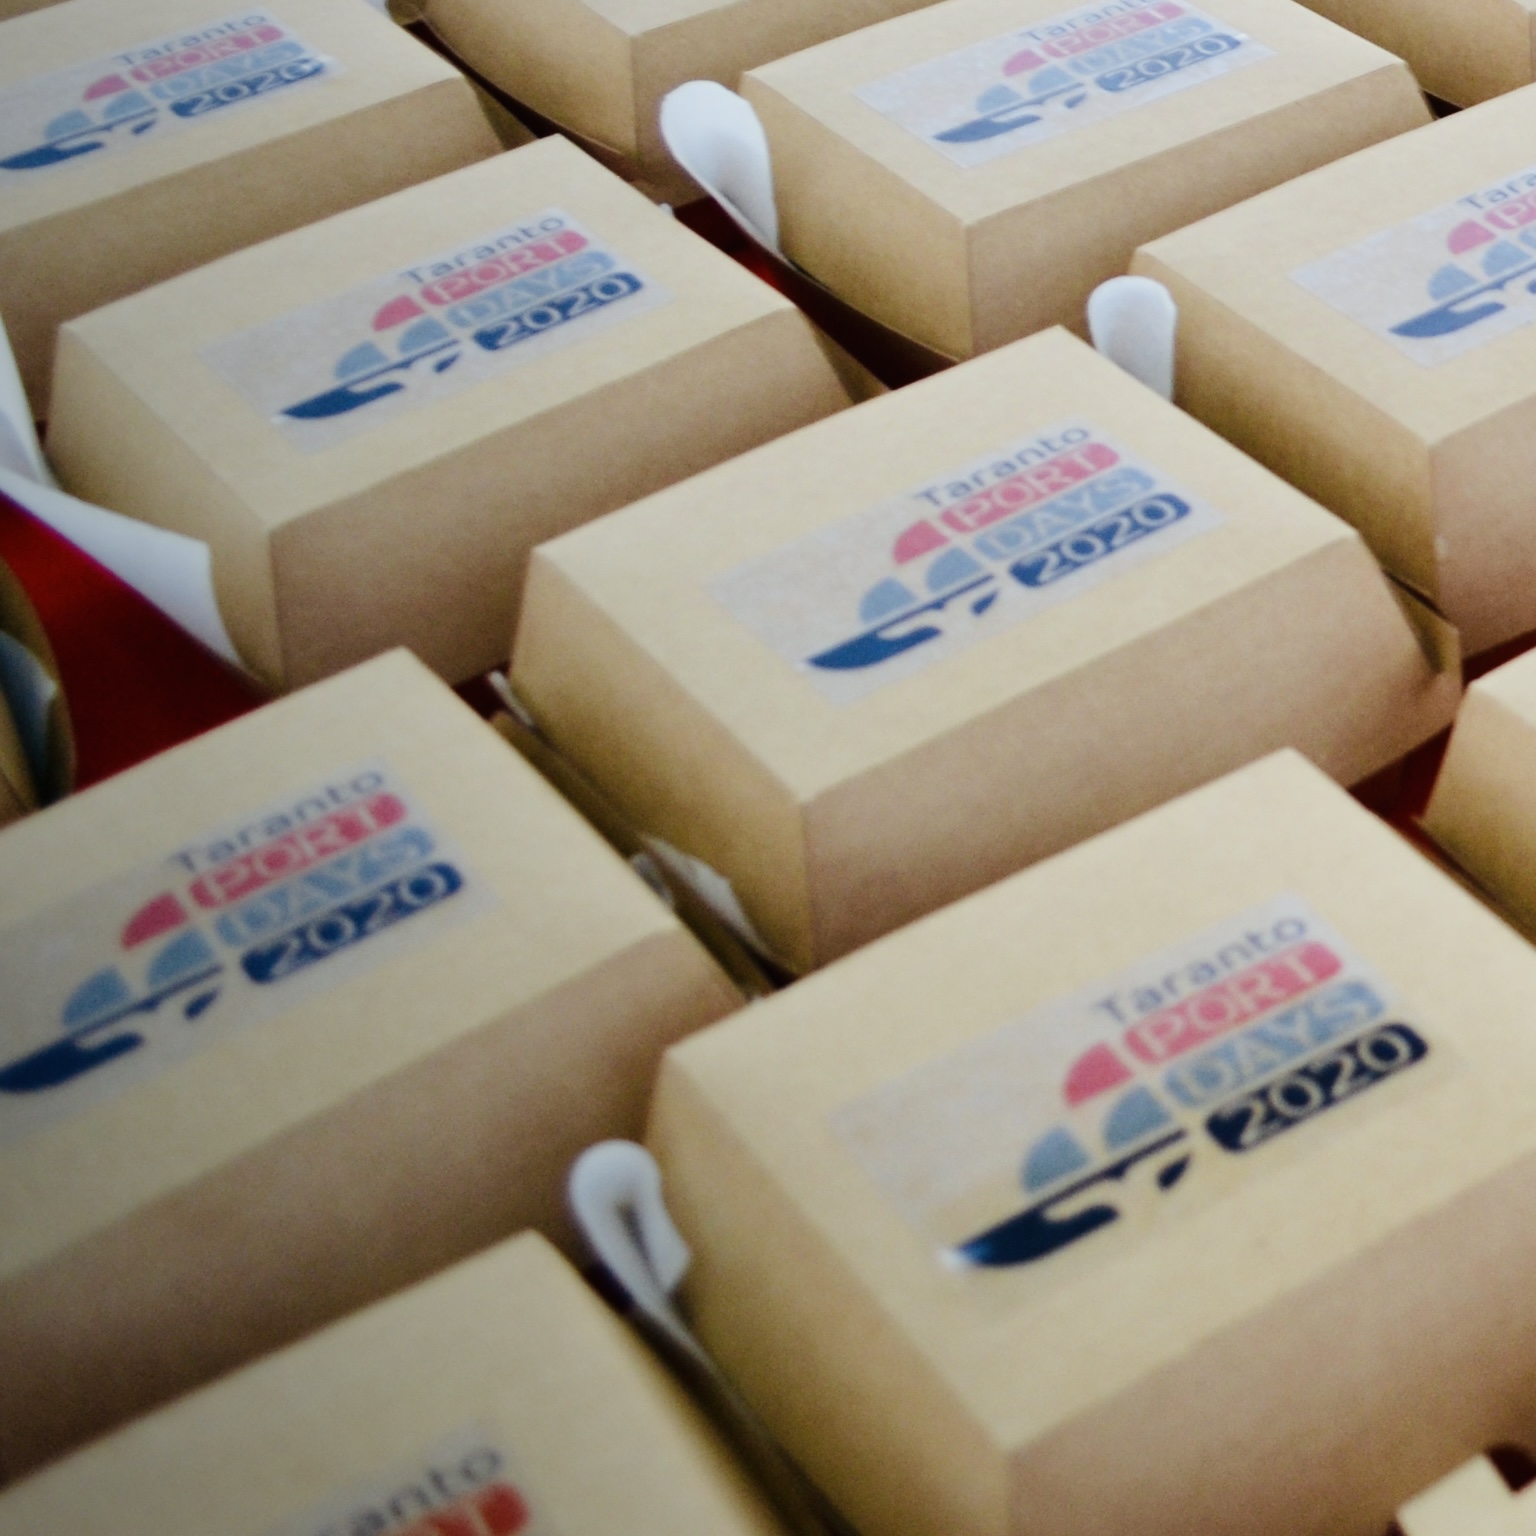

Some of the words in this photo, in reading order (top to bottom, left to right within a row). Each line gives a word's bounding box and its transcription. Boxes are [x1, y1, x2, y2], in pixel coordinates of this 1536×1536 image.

[118, 14, 267, 63] Taranto
[146, 26, 266, 79] PORT
[169, 43, 300, 94] DAYS
[1052, 3, 1168, 55] PORT
[1118, 35, 1232, 87] 2020
[198, 59, 316, 111] 2020
[401, 218, 565, 284] Taranto
[435, 234, 568, 304] PORT
[464, 255, 609, 322] DAYS
[500, 275, 631, 344] 2020
[914, 427, 1090, 506] Taranto
[952, 446, 1097, 531] PORT
[988, 472, 1147, 553] DAYS
[1030, 497, 1176, 580] 2020
[171, 771, 386, 873] Taranto
[211, 796, 384, 907] PORT
[243, 832, 430, 937] DAYS
[283, 865, 450, 973] 2020
[1094, 917, 1306, 1023] Taranto
[1142, 945, 1317, 1063] PORT
[1186, 988, 1377, 1101] DAYS
[1239, 1028, 1412, 1145] 2020
